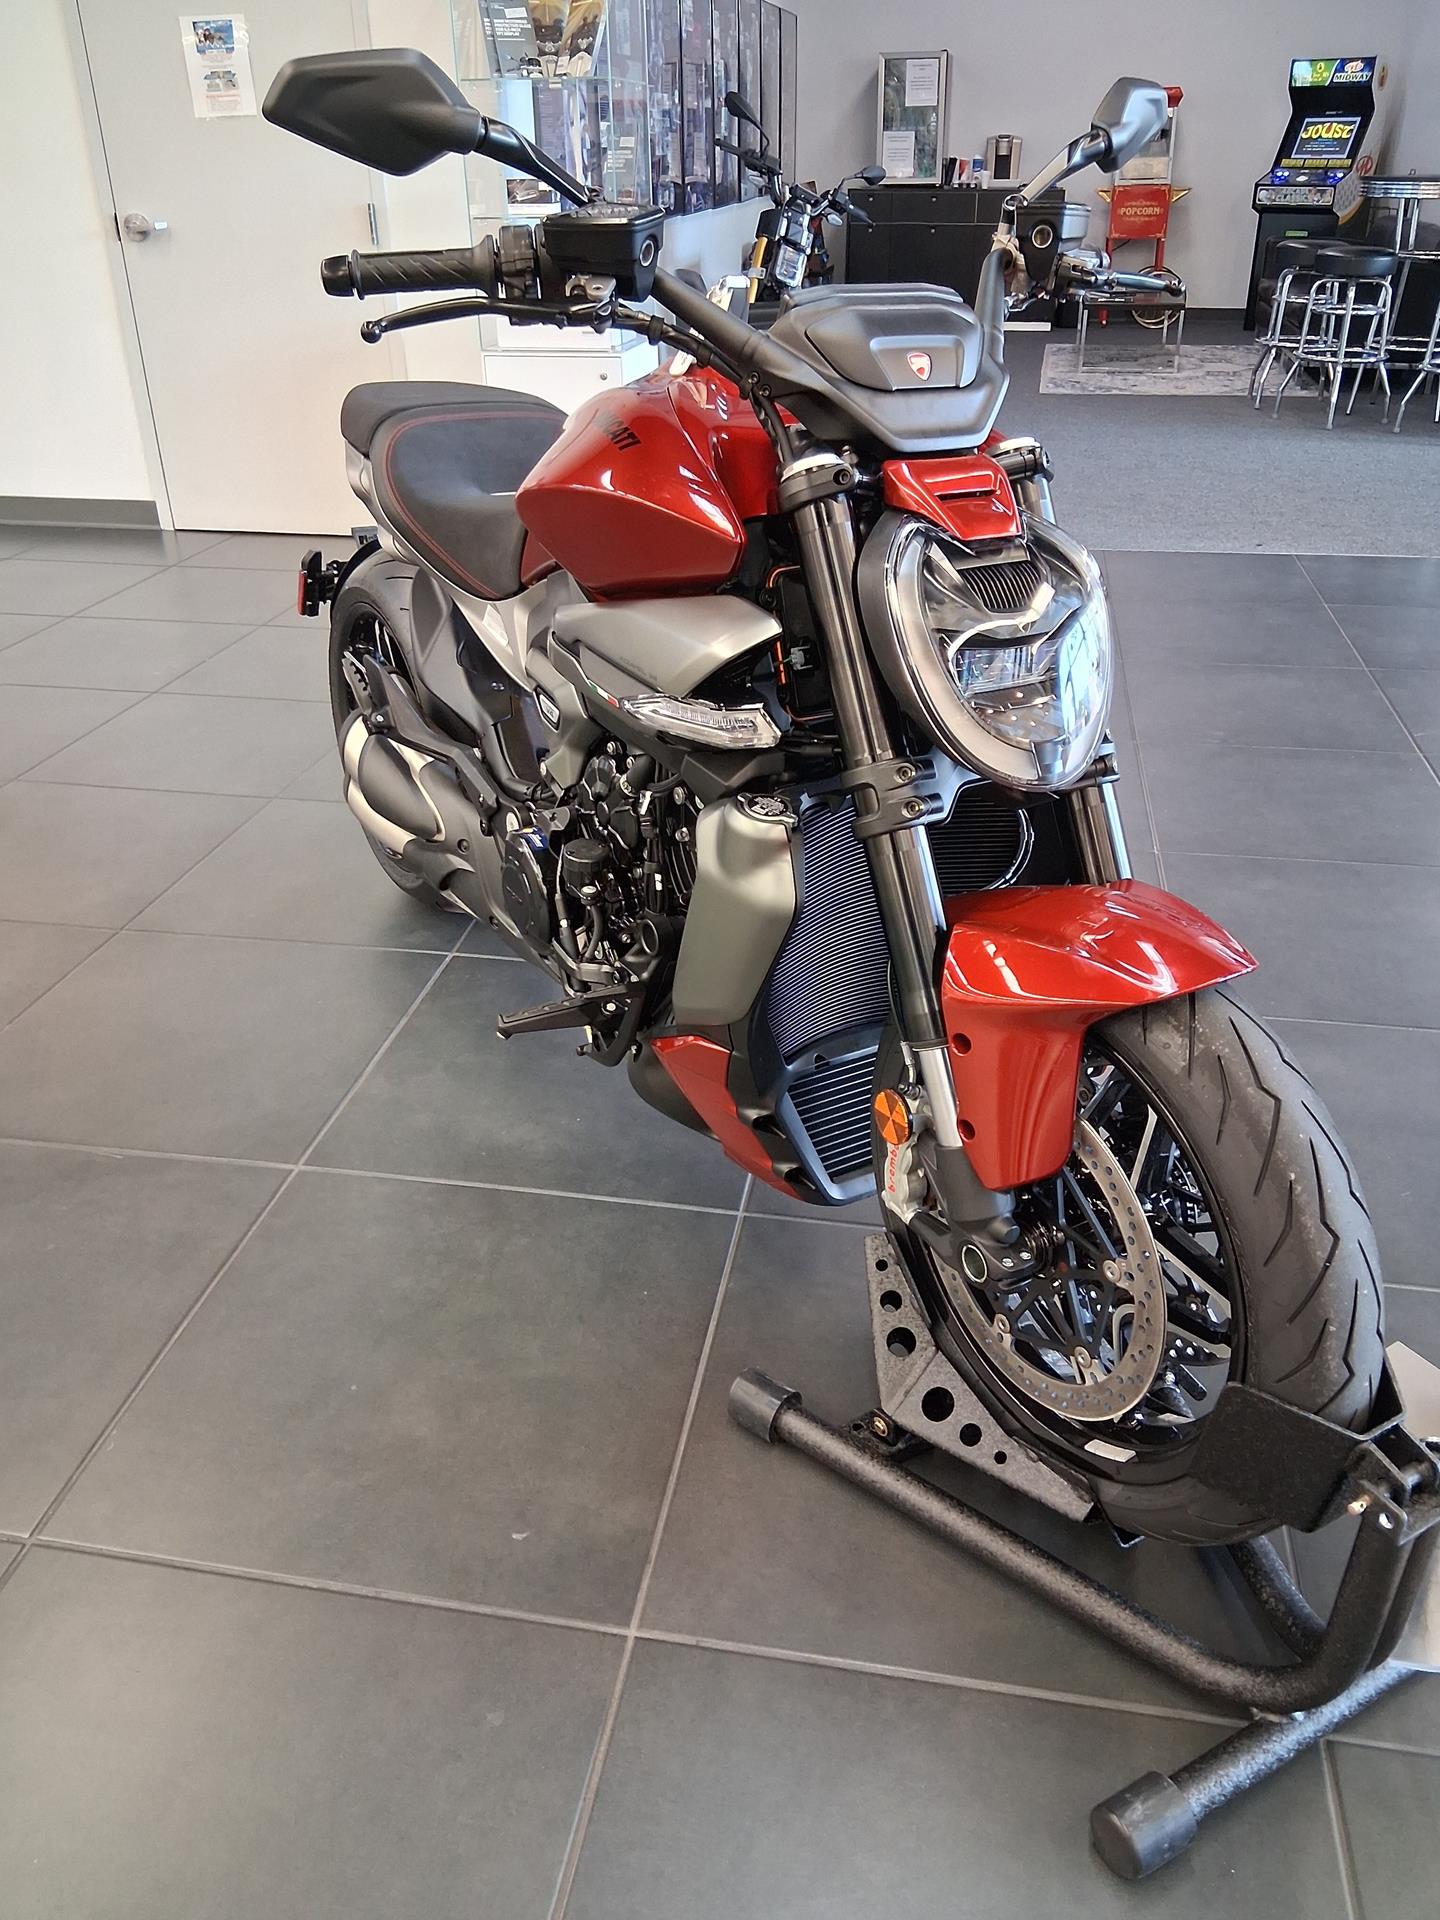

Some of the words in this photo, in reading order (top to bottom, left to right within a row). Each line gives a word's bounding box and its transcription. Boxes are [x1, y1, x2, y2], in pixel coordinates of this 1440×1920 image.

[1334, 72, 1371, 82] MIDWAY
[1301, 122, 1355, 139] JOUST
[1120, 207, 1160, 215] POPCORN
